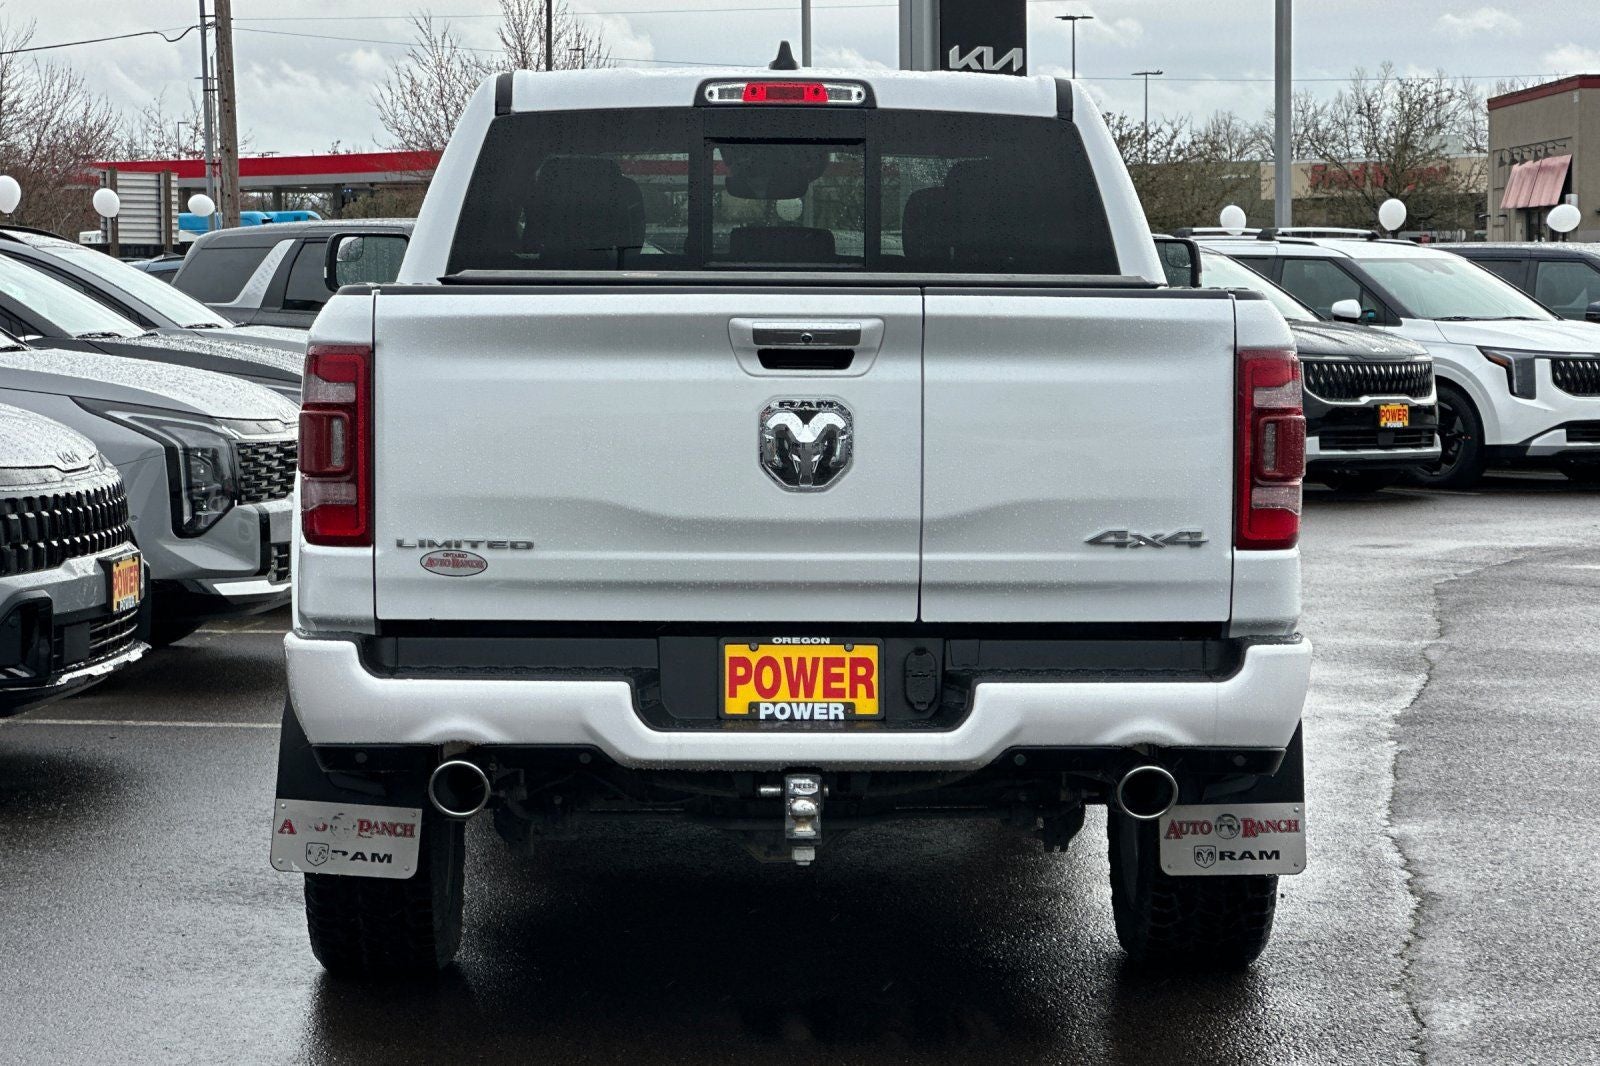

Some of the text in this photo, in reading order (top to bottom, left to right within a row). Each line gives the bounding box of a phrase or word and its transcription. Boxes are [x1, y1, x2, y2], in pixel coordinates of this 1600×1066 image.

[948, 44, 1023, 72] KIA
[778, 401, 834, 409] RAM
[1380, 408, 1408, 422] POWER
[396, 538, 535, 550] LIMITED
[113, 564, 139, 599] POWER
[728, 656, 875, 699] POWER
[759, 703, 845, 720] POWER
[357, 818, 416, 838] RANCH
[1164, 817, 1301, 840] AUTO RANCH
[1219, 850, 1280, 861] RAM
